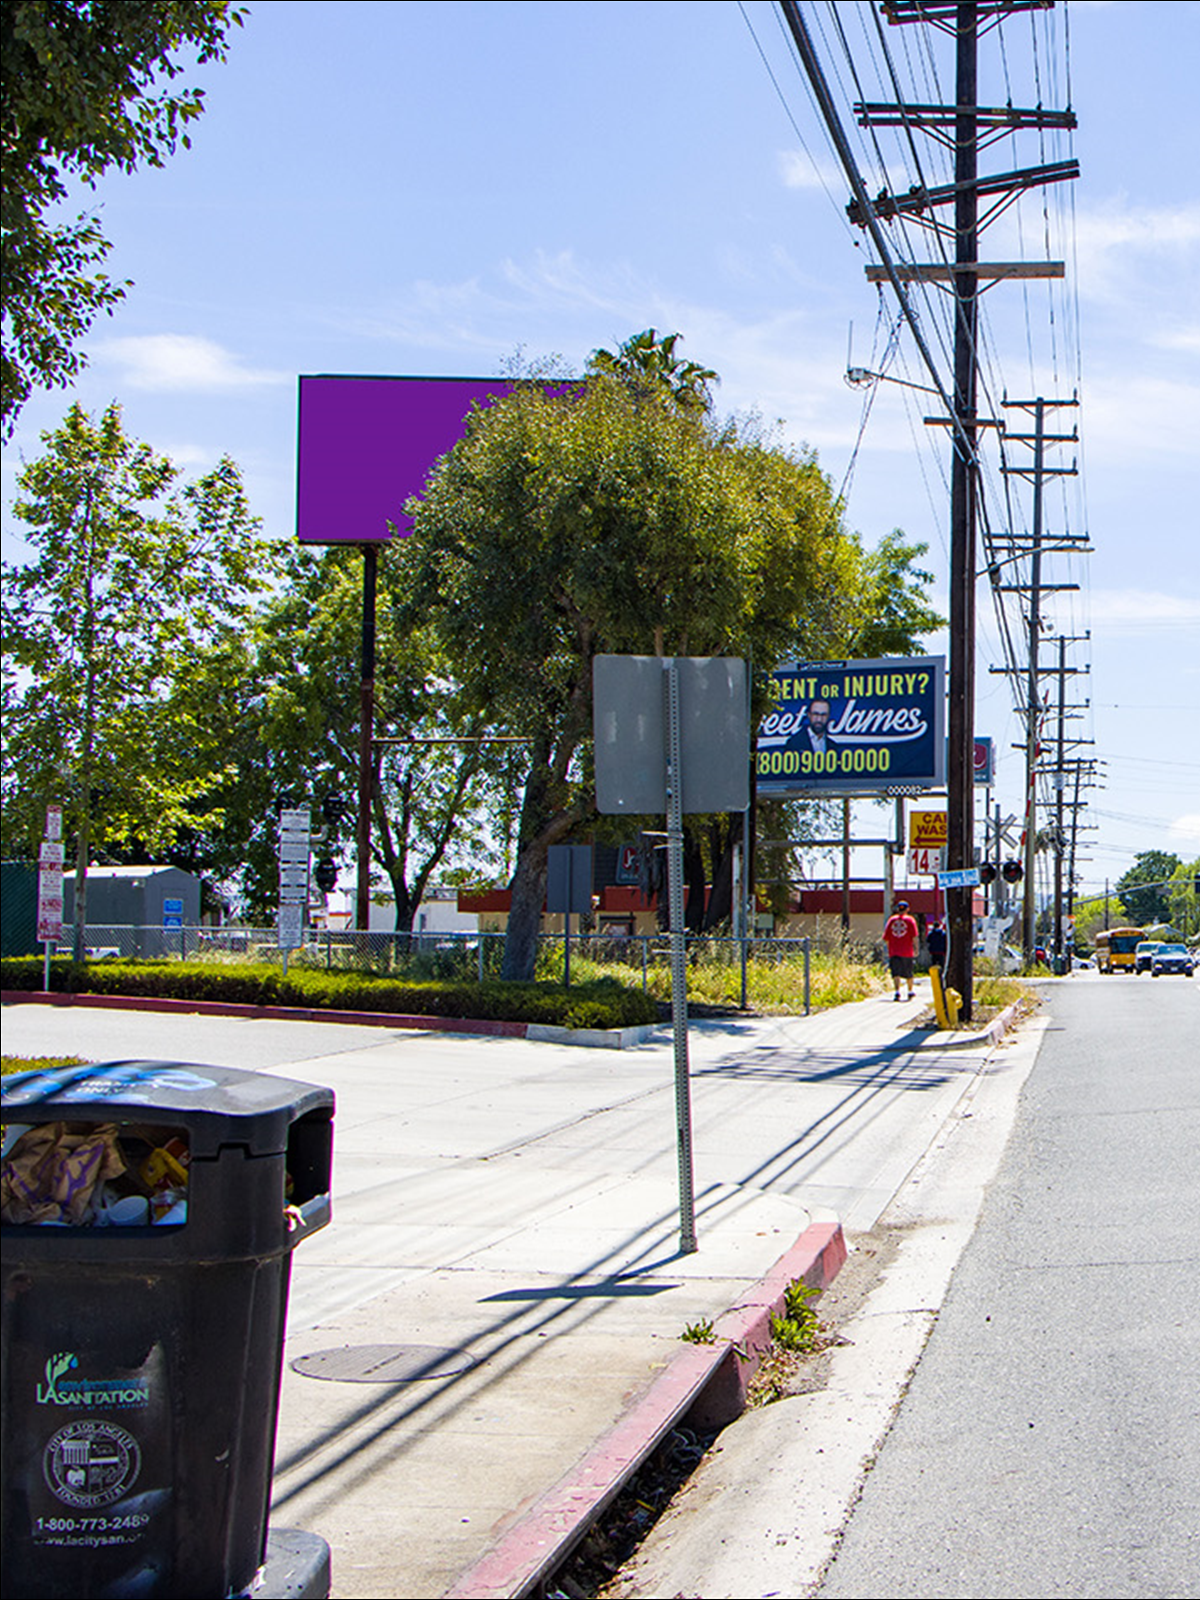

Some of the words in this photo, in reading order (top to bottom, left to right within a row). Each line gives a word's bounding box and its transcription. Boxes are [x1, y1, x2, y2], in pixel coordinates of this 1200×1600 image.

[820, 684, 840, 699] OR
[843, 672, 930, 699] INJURY?
[758, 704, 807, 735] eet
[828, 699, 922, 734] James
[916, 824, 947, 836] WAS
[912, 849, 929, 873] 14
